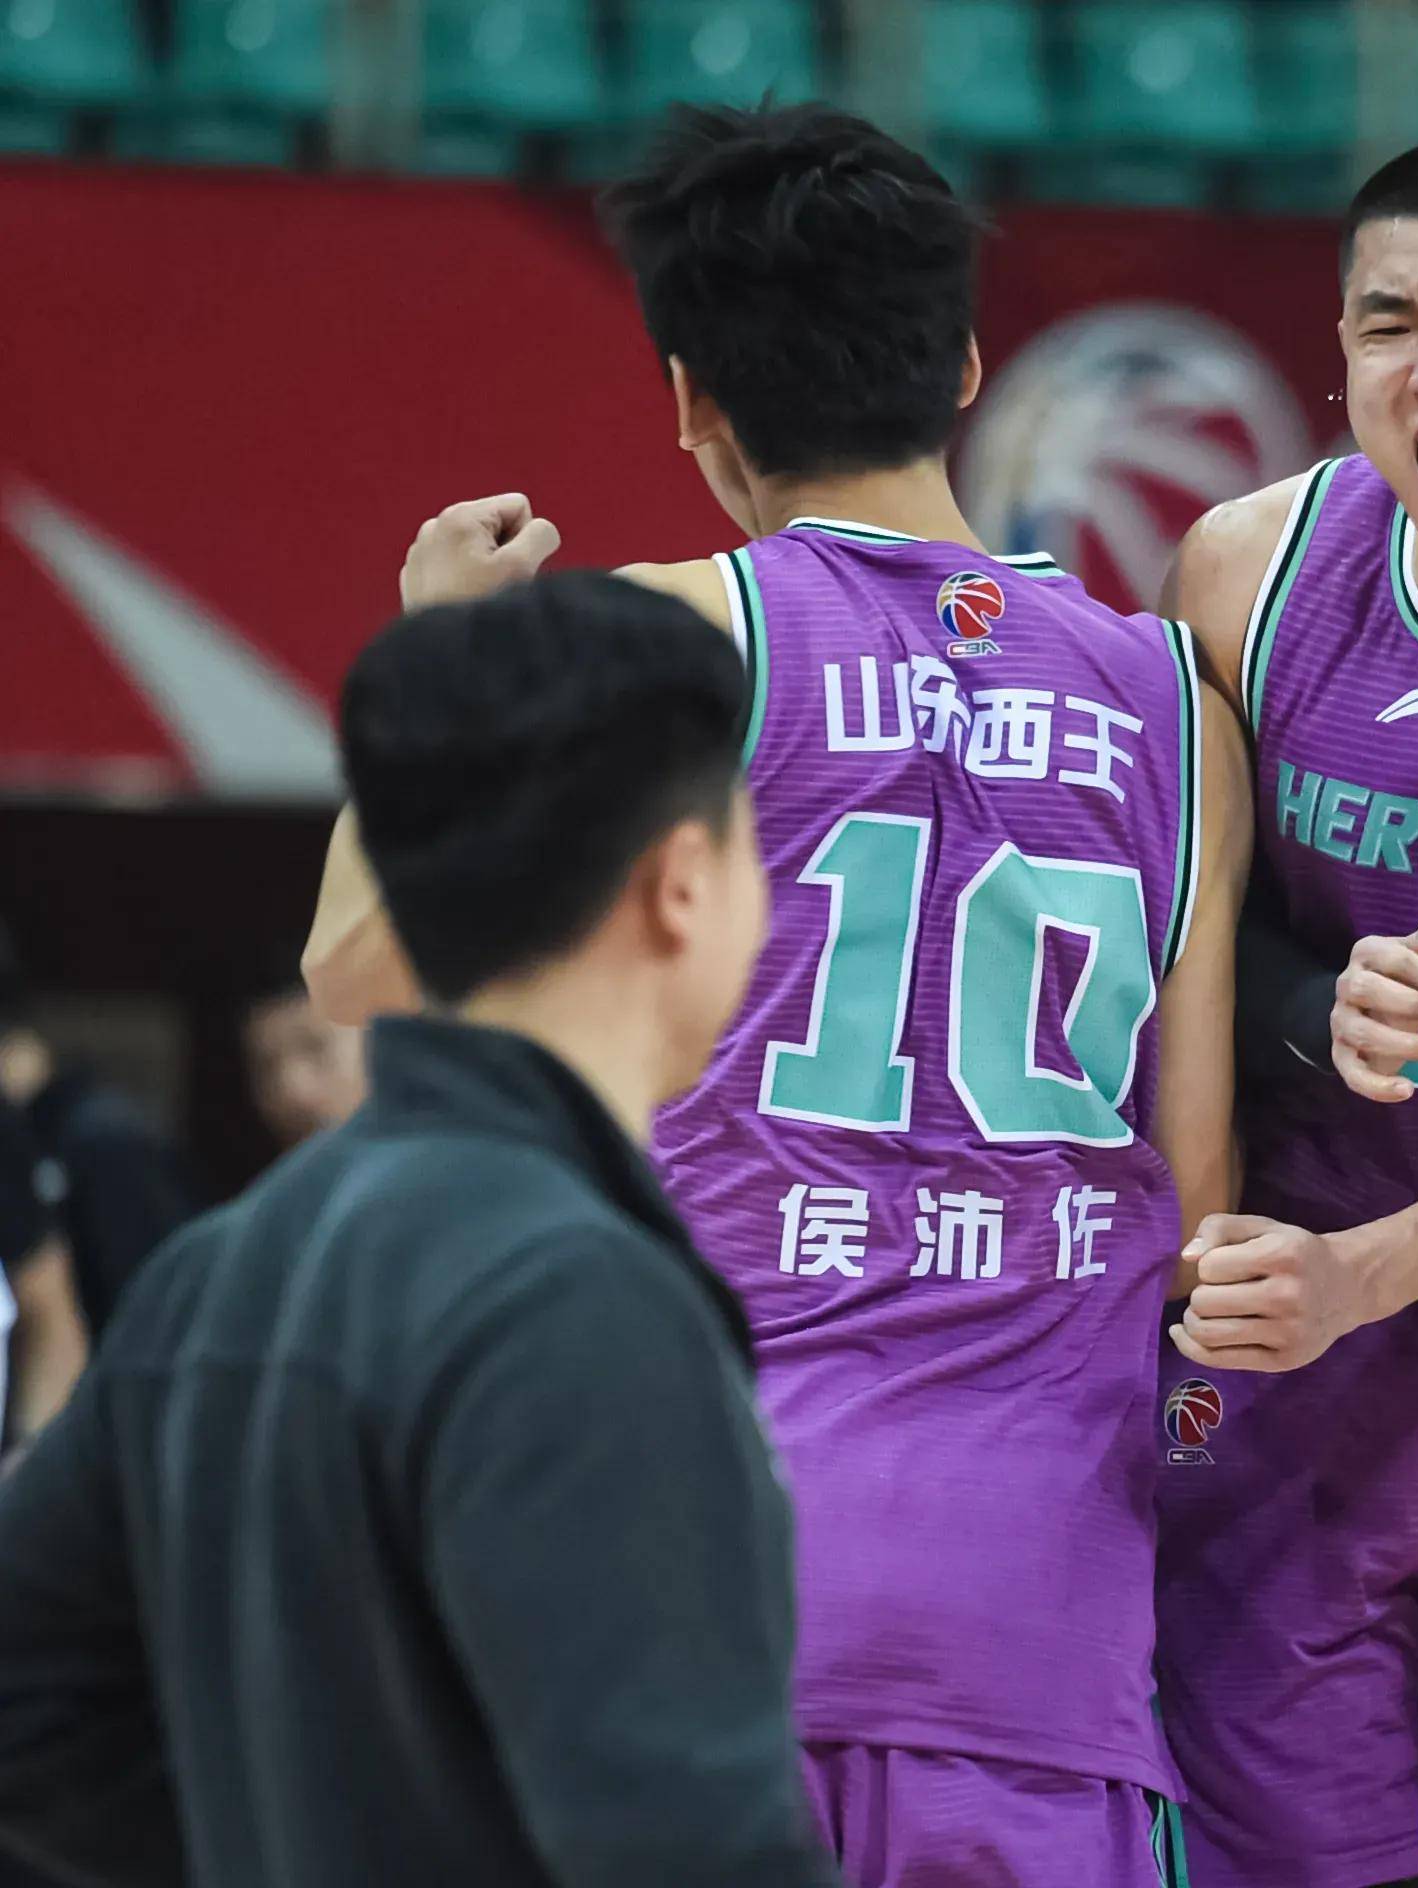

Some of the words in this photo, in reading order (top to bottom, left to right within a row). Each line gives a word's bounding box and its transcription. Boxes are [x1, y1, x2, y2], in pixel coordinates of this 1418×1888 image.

[823, 656, 1144, 803] 山东西王
[757, 811, 1156, 1148] 10
[778, 1183, 1117, 1280] 侯沛佐
